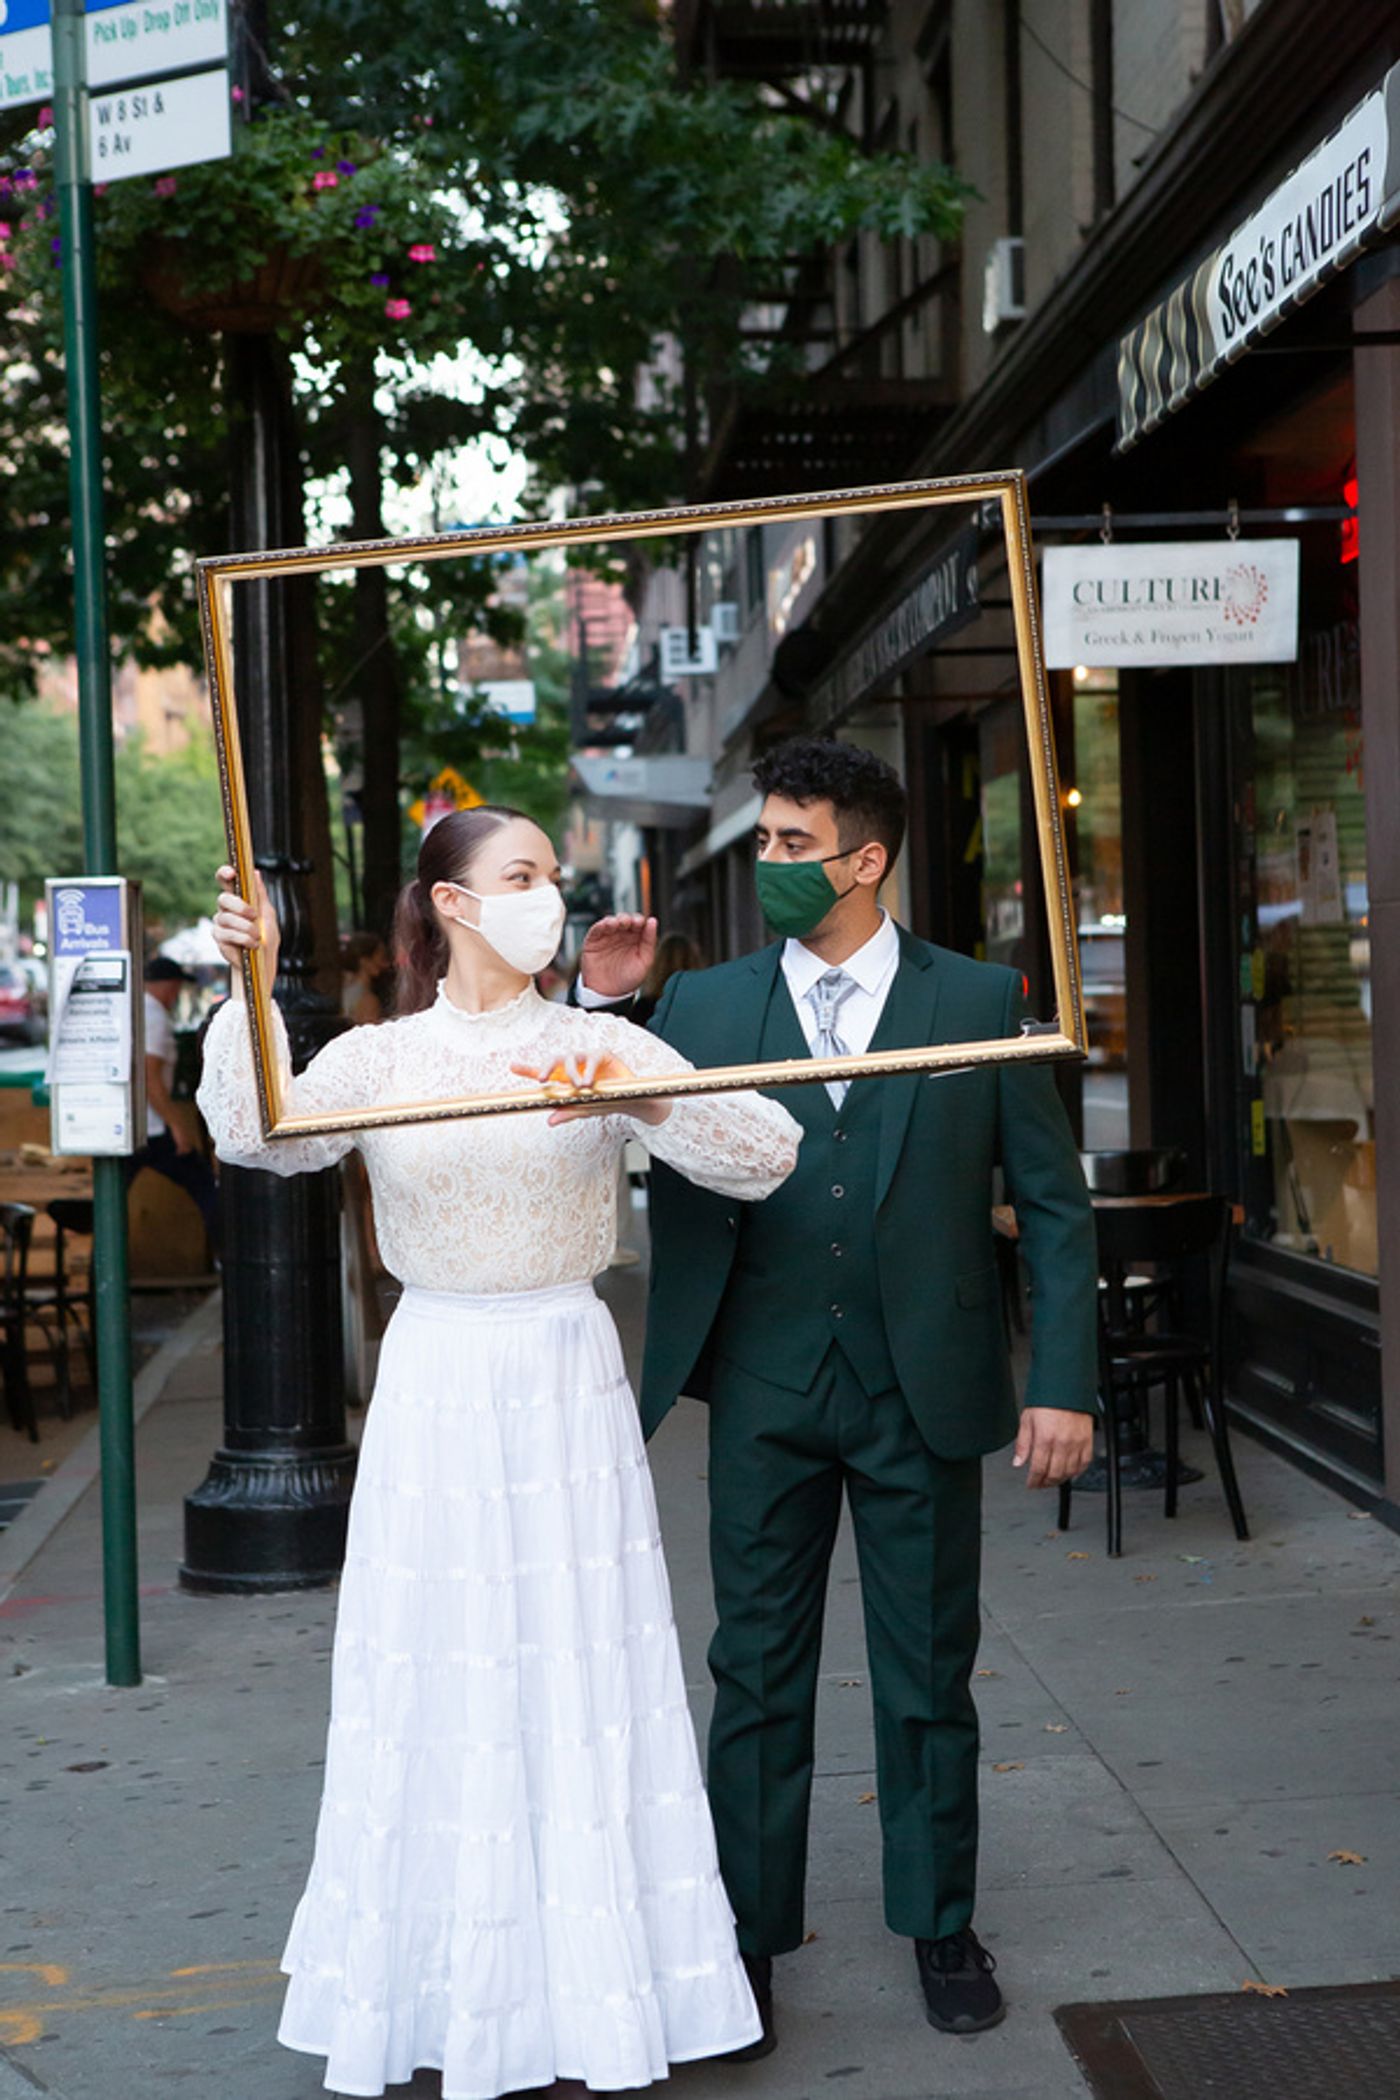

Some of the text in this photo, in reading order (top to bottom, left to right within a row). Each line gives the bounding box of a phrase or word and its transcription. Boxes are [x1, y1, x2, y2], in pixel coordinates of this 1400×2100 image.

[97, 91, 165, 126] W 8 St &
[98, 133, 131, 158] 6 Av
[1218, 146, 1371, 339] See's CANDIES
[1084, 629, 1129, 647] Greek
[1133, 631, 1146, 646] &
[1206, 627, 1254, 648] Yogurt
[86, 924, 110, 936] Bus
[61, 938, 110, 950] Arrivals
